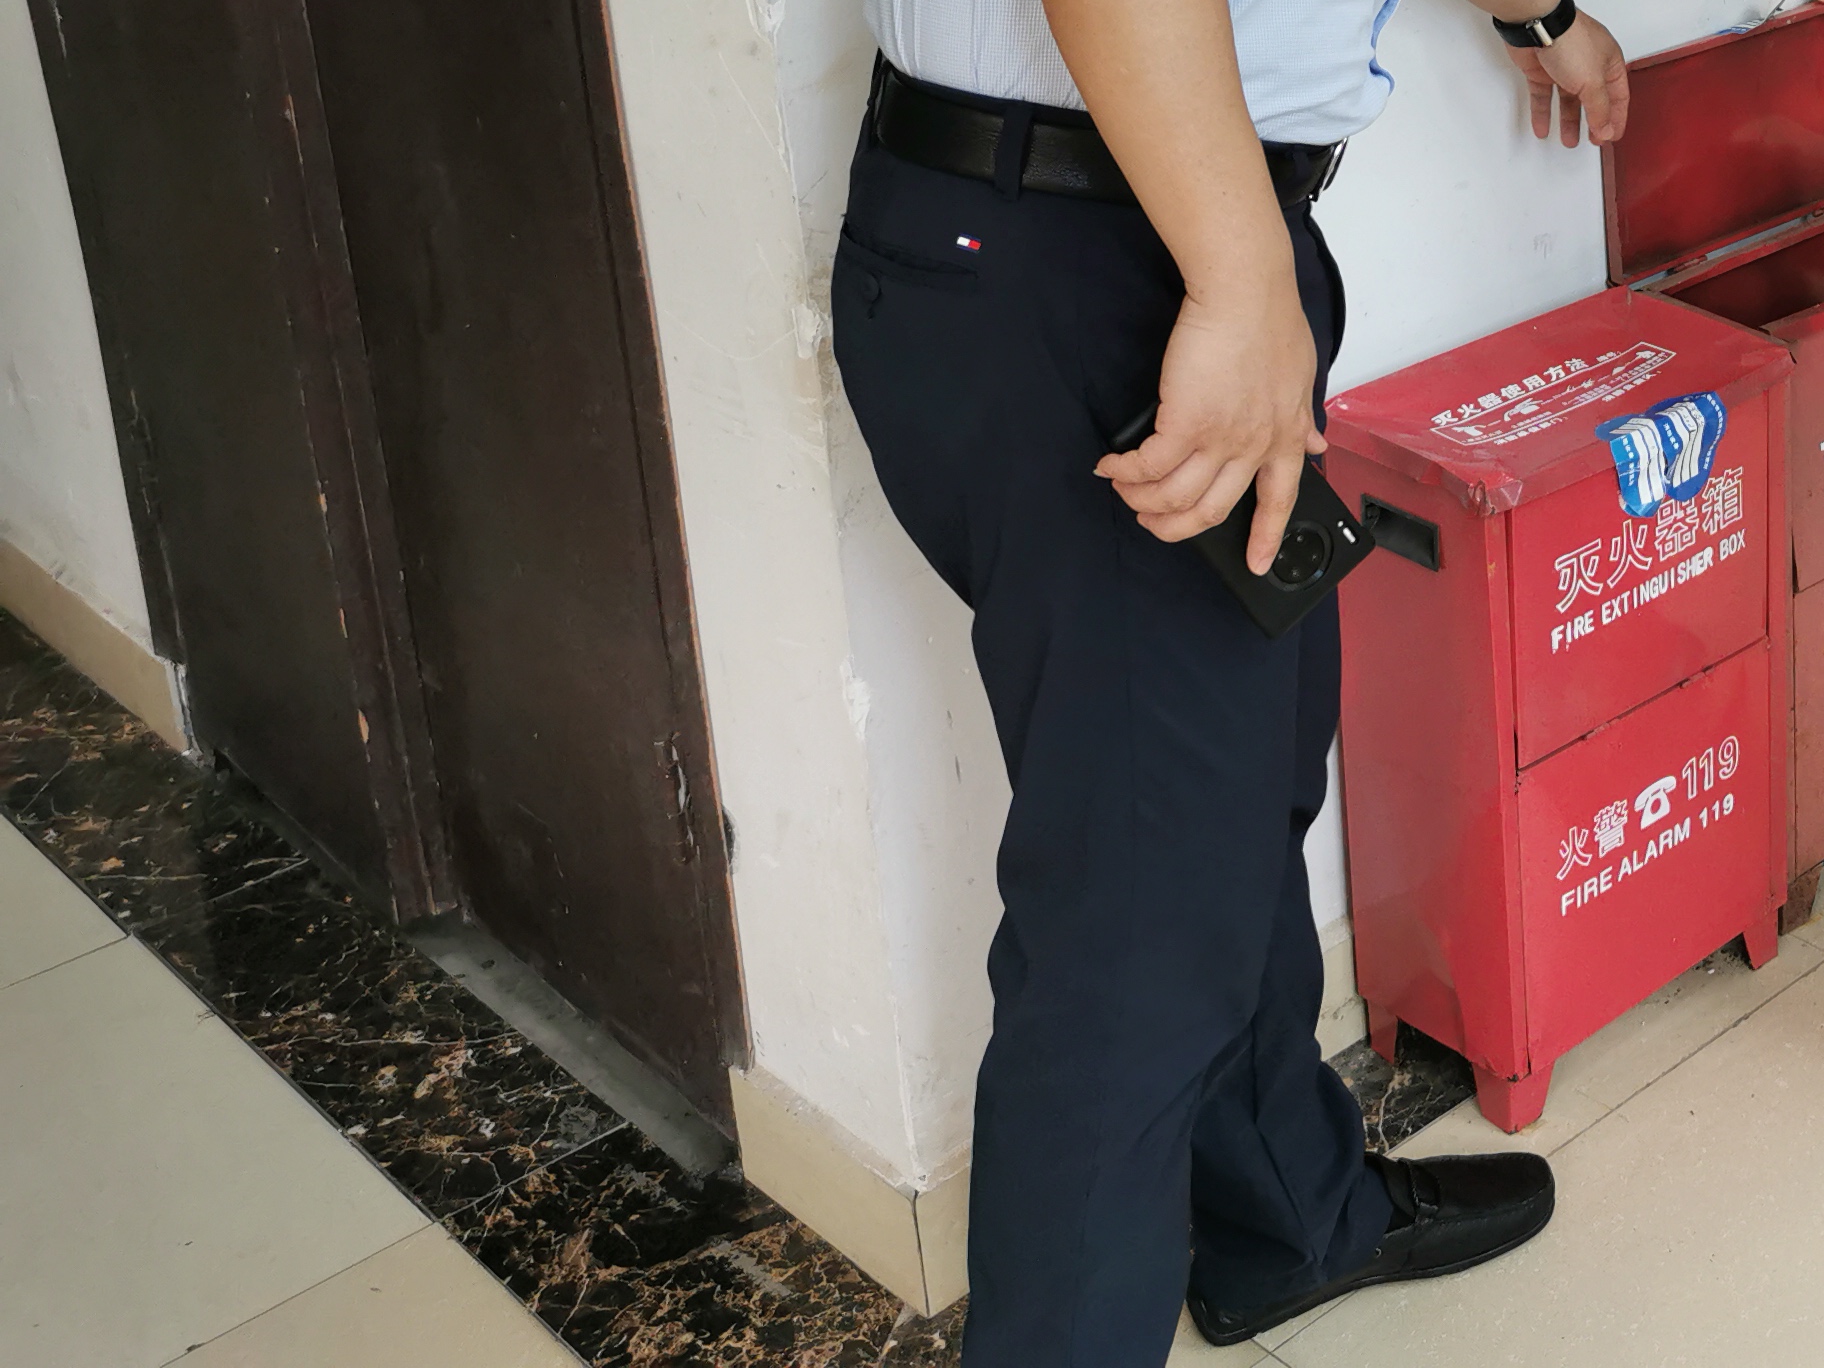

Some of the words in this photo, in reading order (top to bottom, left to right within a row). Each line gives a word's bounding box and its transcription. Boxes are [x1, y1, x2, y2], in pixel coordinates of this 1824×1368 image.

[1431, 357, 1590, 427] 灭火器使用方法
[1550, 609, 1595, 651] FIRE
[1600, 545, 1714, 626] EXTINGUISHER
[1718, 528, 1747, 562] BOX
[1554, 466, 1744, 614] 灭火器箱
[1556, 798, 1629, 881] 火警
[1681, 734, 1741, 801] 119
[1560, 865, 1613, 917] FIRE
[1617, 816, 1691, 883] ALARM
[1699, 792, 1735, 829] 119
